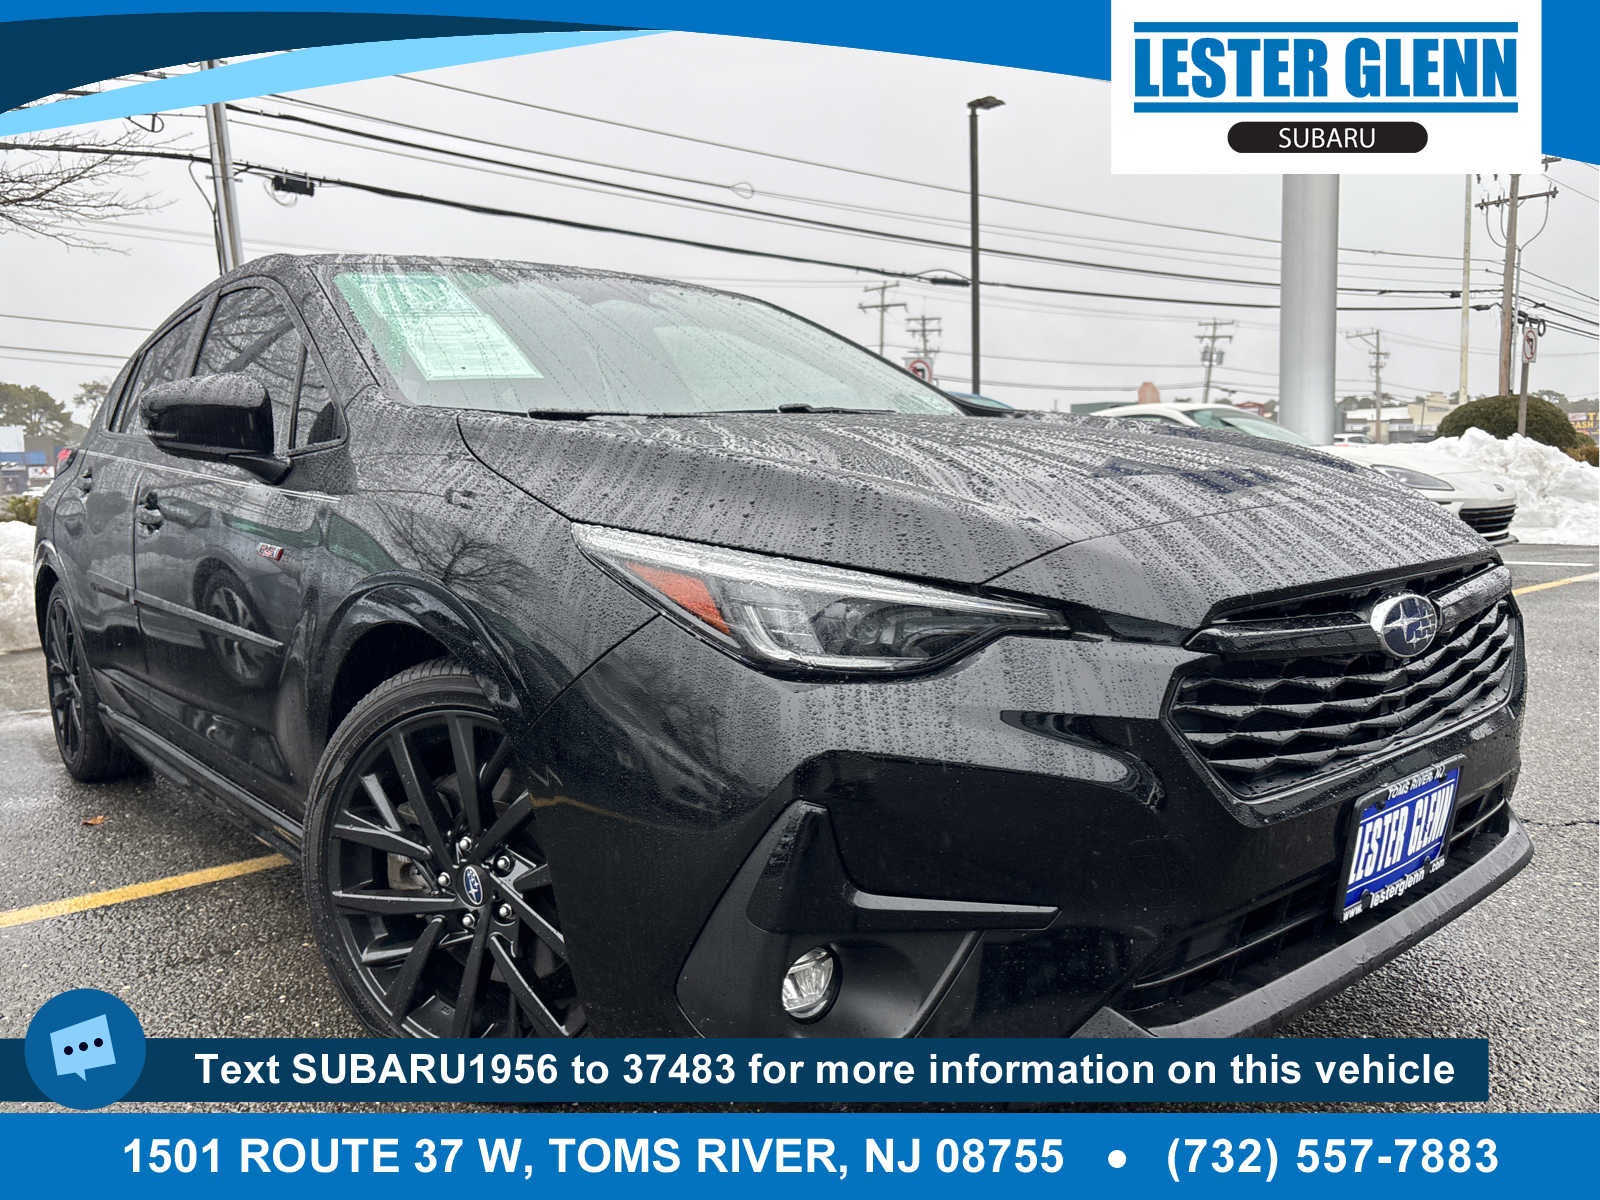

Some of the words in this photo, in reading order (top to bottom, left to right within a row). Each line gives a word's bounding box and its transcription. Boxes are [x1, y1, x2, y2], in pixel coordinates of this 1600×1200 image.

[1347, 805, 1409, 886] LESTER
[1407, 783, 1454, 857] GLENN
[1369, 868, 1425, 909] lesterglenn
